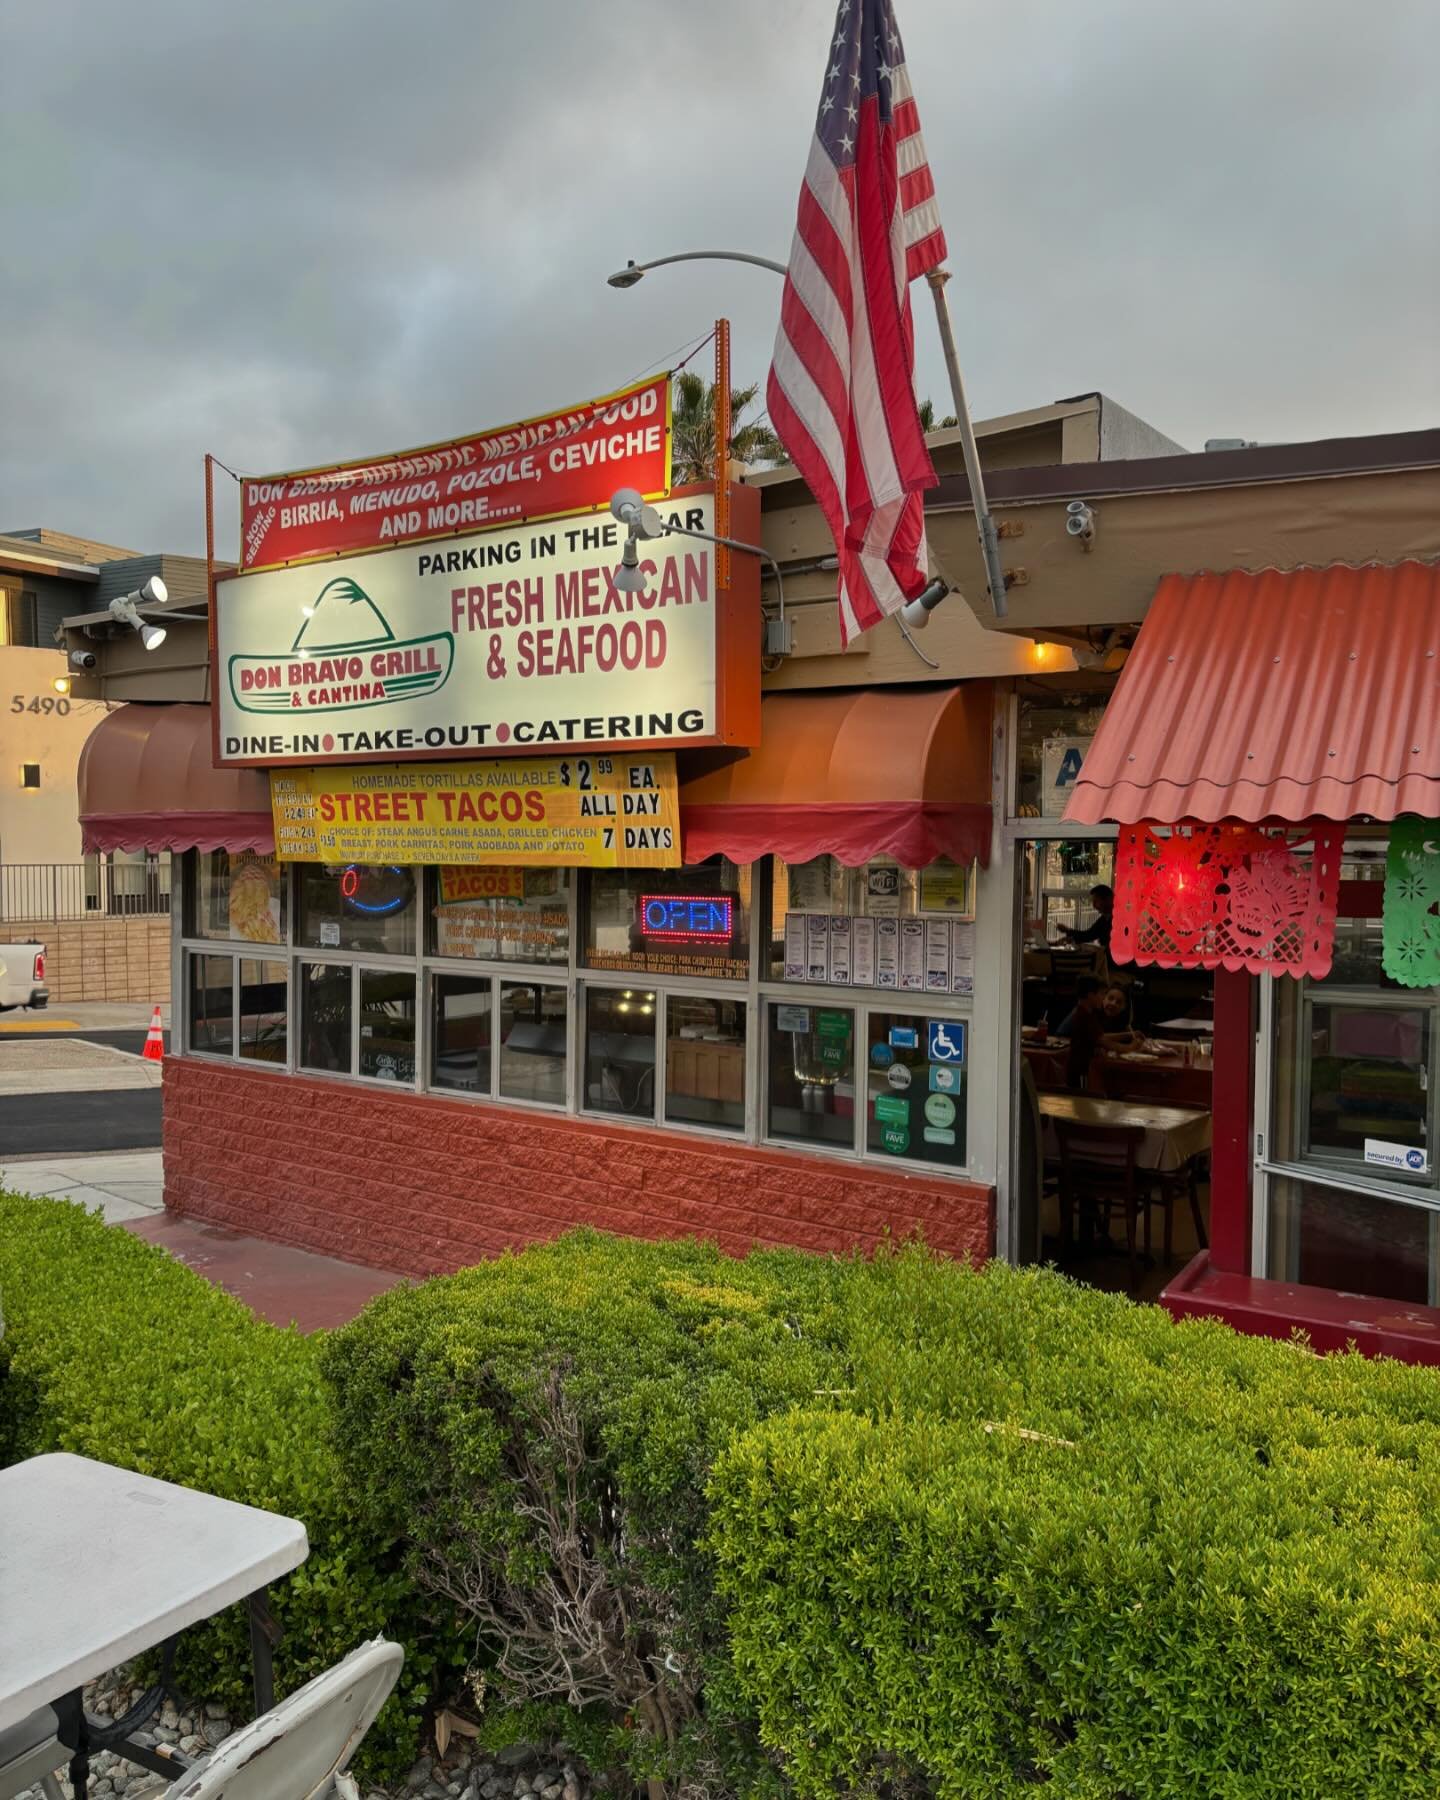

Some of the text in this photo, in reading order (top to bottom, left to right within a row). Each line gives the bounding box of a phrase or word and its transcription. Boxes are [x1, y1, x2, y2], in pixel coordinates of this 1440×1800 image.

[281, 426, 661, 528] BIRRIA, MENUDO, POZOLE, CEVICHE
[248, 484, 285, 506] DON
[246, 506, 277, 564] NOW SERVING
[379, 511, 421, 539] AND
[418, 541, 521, 576] PARKING
[531, 534, 556, 559] IN
[565, 523, 618, 552] THE
[451, 576, 544, 633] FRESH
[487, 619, 667, 680] & SEAFOOD
[241, 647, 442, 691] DON BRAVO GRILL
[10, 695, 71, 716] 5490
[291, 682, 385, 707] & CANTINA
[226, 710, 704, 755] DINE-IN TAKE-OUT CATERING
[352, 771, 556, 789] HOMEMADE TORTILLAS AVAILABLE
[1056, 748, 1083, 786] A
[319, 792, 428, 822] STREET
[437, 790, 545, 822] TACOS
[581, 794, 659, 816] ALL DAY
[508, 828, 549, 838] GRILLED
[552, 828, 597, 838] CHICKEN
[603, 828, 672, 849] 7 DAYS
[444, 876, 510, 897] TACOS
[645, 901, 728, 932] OPEN
[886, 1133, 905, 1144] FAVE
